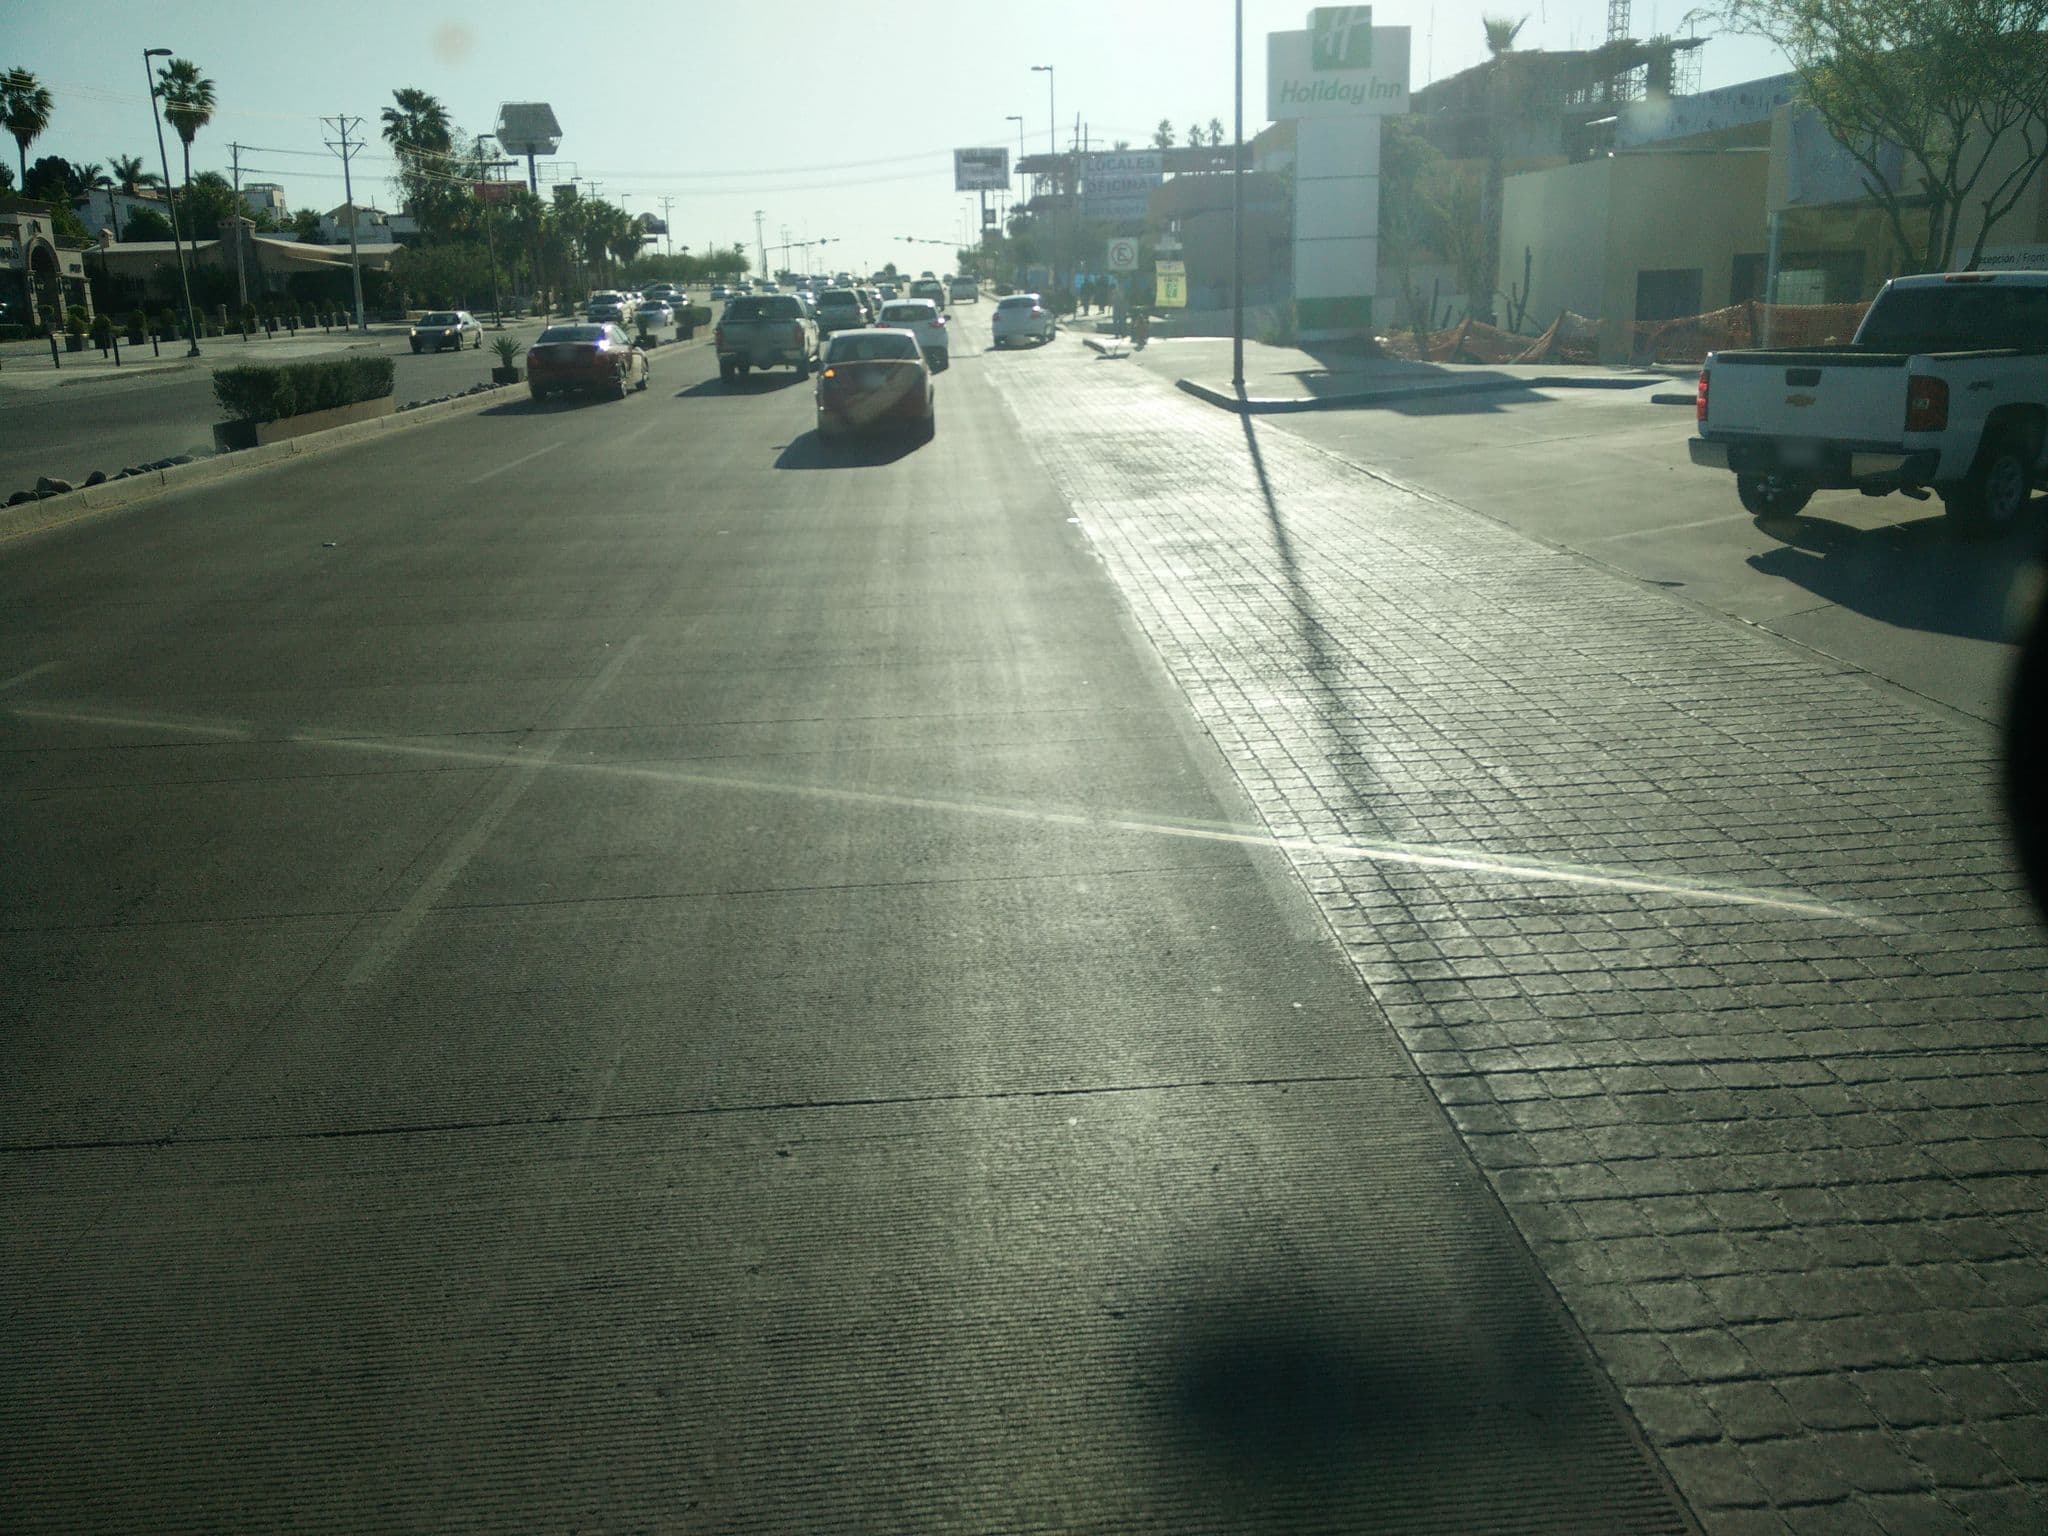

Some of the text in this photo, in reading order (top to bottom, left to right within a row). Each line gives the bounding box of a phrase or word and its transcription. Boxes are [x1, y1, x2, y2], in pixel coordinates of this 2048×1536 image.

[1280, 75, 1401, 105] Holiday Inn
[1087, 158, 1154, 172] LOCALES
